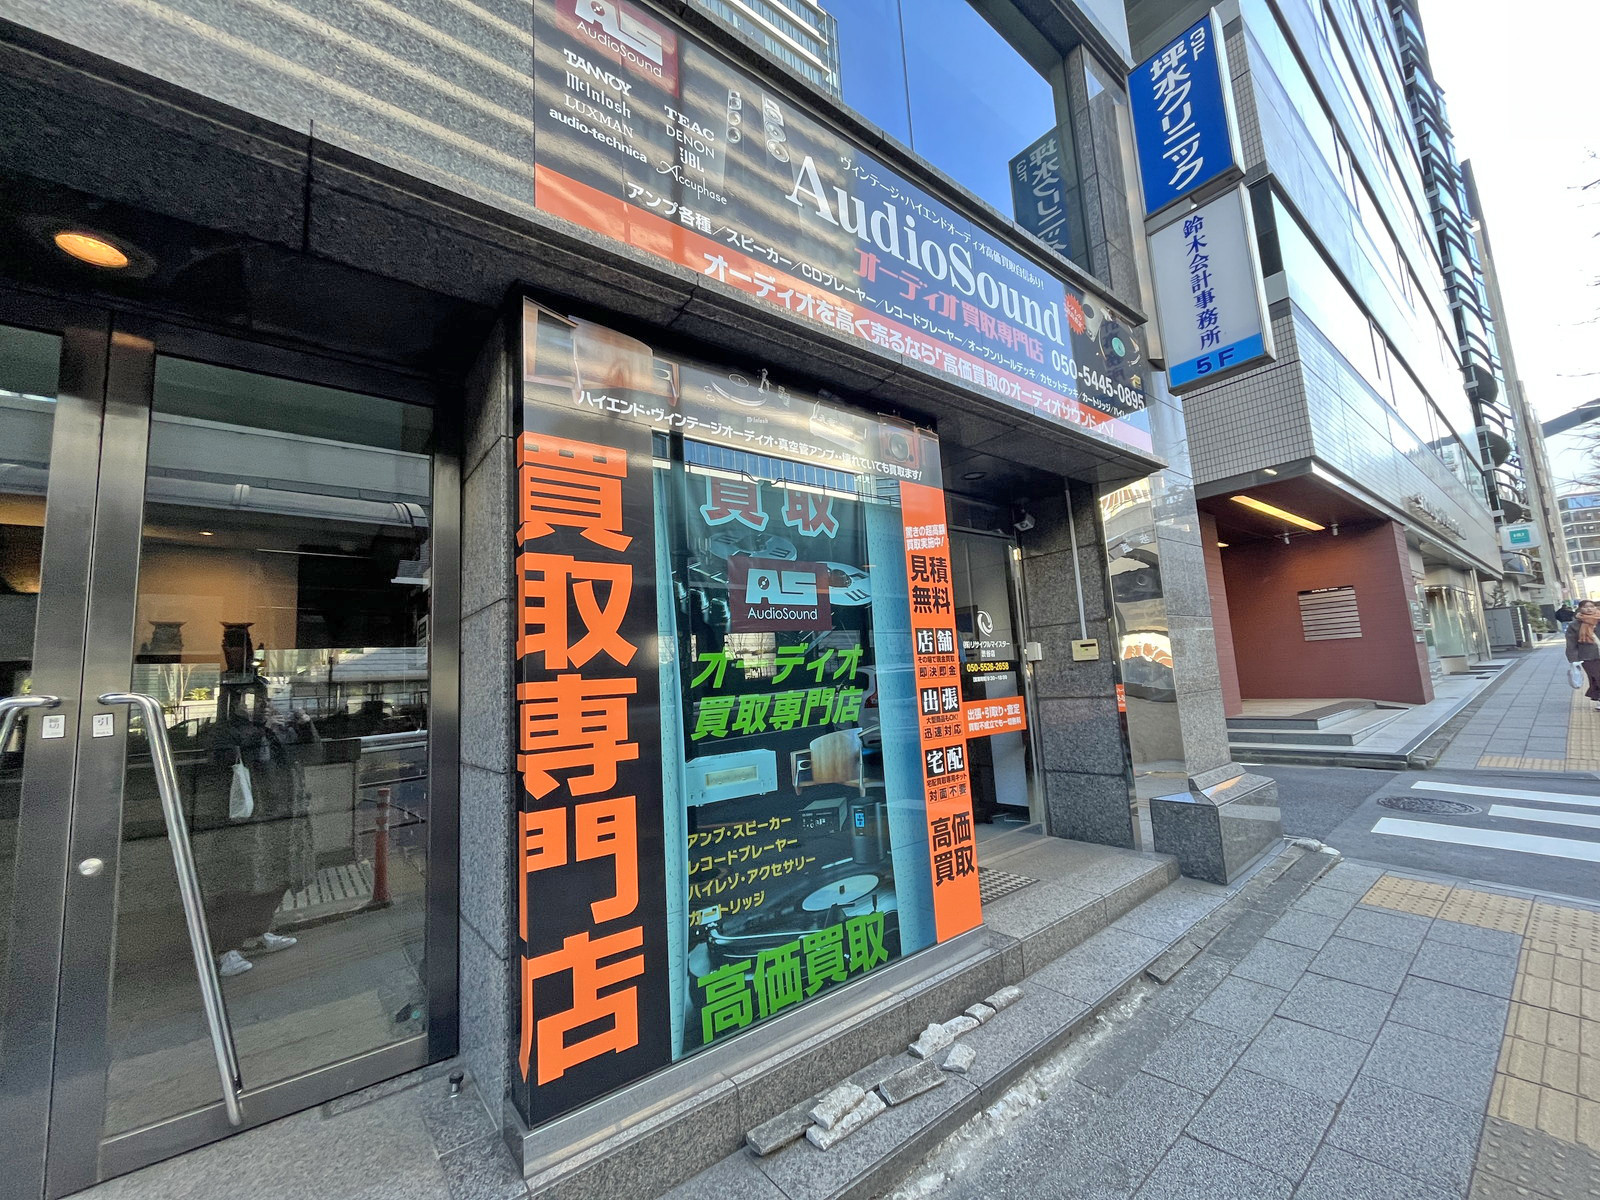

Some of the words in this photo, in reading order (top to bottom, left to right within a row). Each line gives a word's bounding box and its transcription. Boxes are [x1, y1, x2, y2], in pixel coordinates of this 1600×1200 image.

[576, 21, 662, 78] AudioSound
[1190, 27, 1205, 61] 3F
[563, 48, 632, 98] TANNOY
[548, 107, 648, 164] audio-technica
[563, 93, 634, 139] LUXMAN
[664, 104, 715, 142] TEAC
[1150, 40, 1204, 191] 坪水クリニック
[666, 123, 715, 159] DENON
[656, 160, 727, 205] Accuphase
[784, 155, 1065, 347] AudioSound
[1183, 215, 1221, 350] 鈴木会計事務所
[853, 247, 1045, 365] オーディオ買取専門店
[1051, 350, 1146, 412] 050-5445-0895
[1196, 348, 1235, 375] 5F
[745, 568, 818, 606] AS
[911, 555, 949, 584] 見積
[747, 606, 818, 621] AudioSound
[912, 585, 951, 614] 無料
[918, 630, 953, 654] 店舗
[690, 643, 864, 689] オーディオ
[919, 665, 957, 678] 即決即金
[690, 686, 864, 741] 買取専門店
[922, 687, 958, 713] 出張
[924, 723, 963, 739] 迅速対応
[516, 431, 645, 1087] 買取専門店
[927, 746, 964, 774] 宅配
[929, 783, 967, 802] 対面不要
[688, 816, 792, 849] アンプ・スピーカー
[931, 811, 972, 851] 高価
[688, 839, 798, 875] レコードプレーヤー
[934, 845, 975, 886] 買取
[688, 856, 816, 901] ハイレゾ・アクセサリー
[697, 911, 889, 1044] 高価買取
